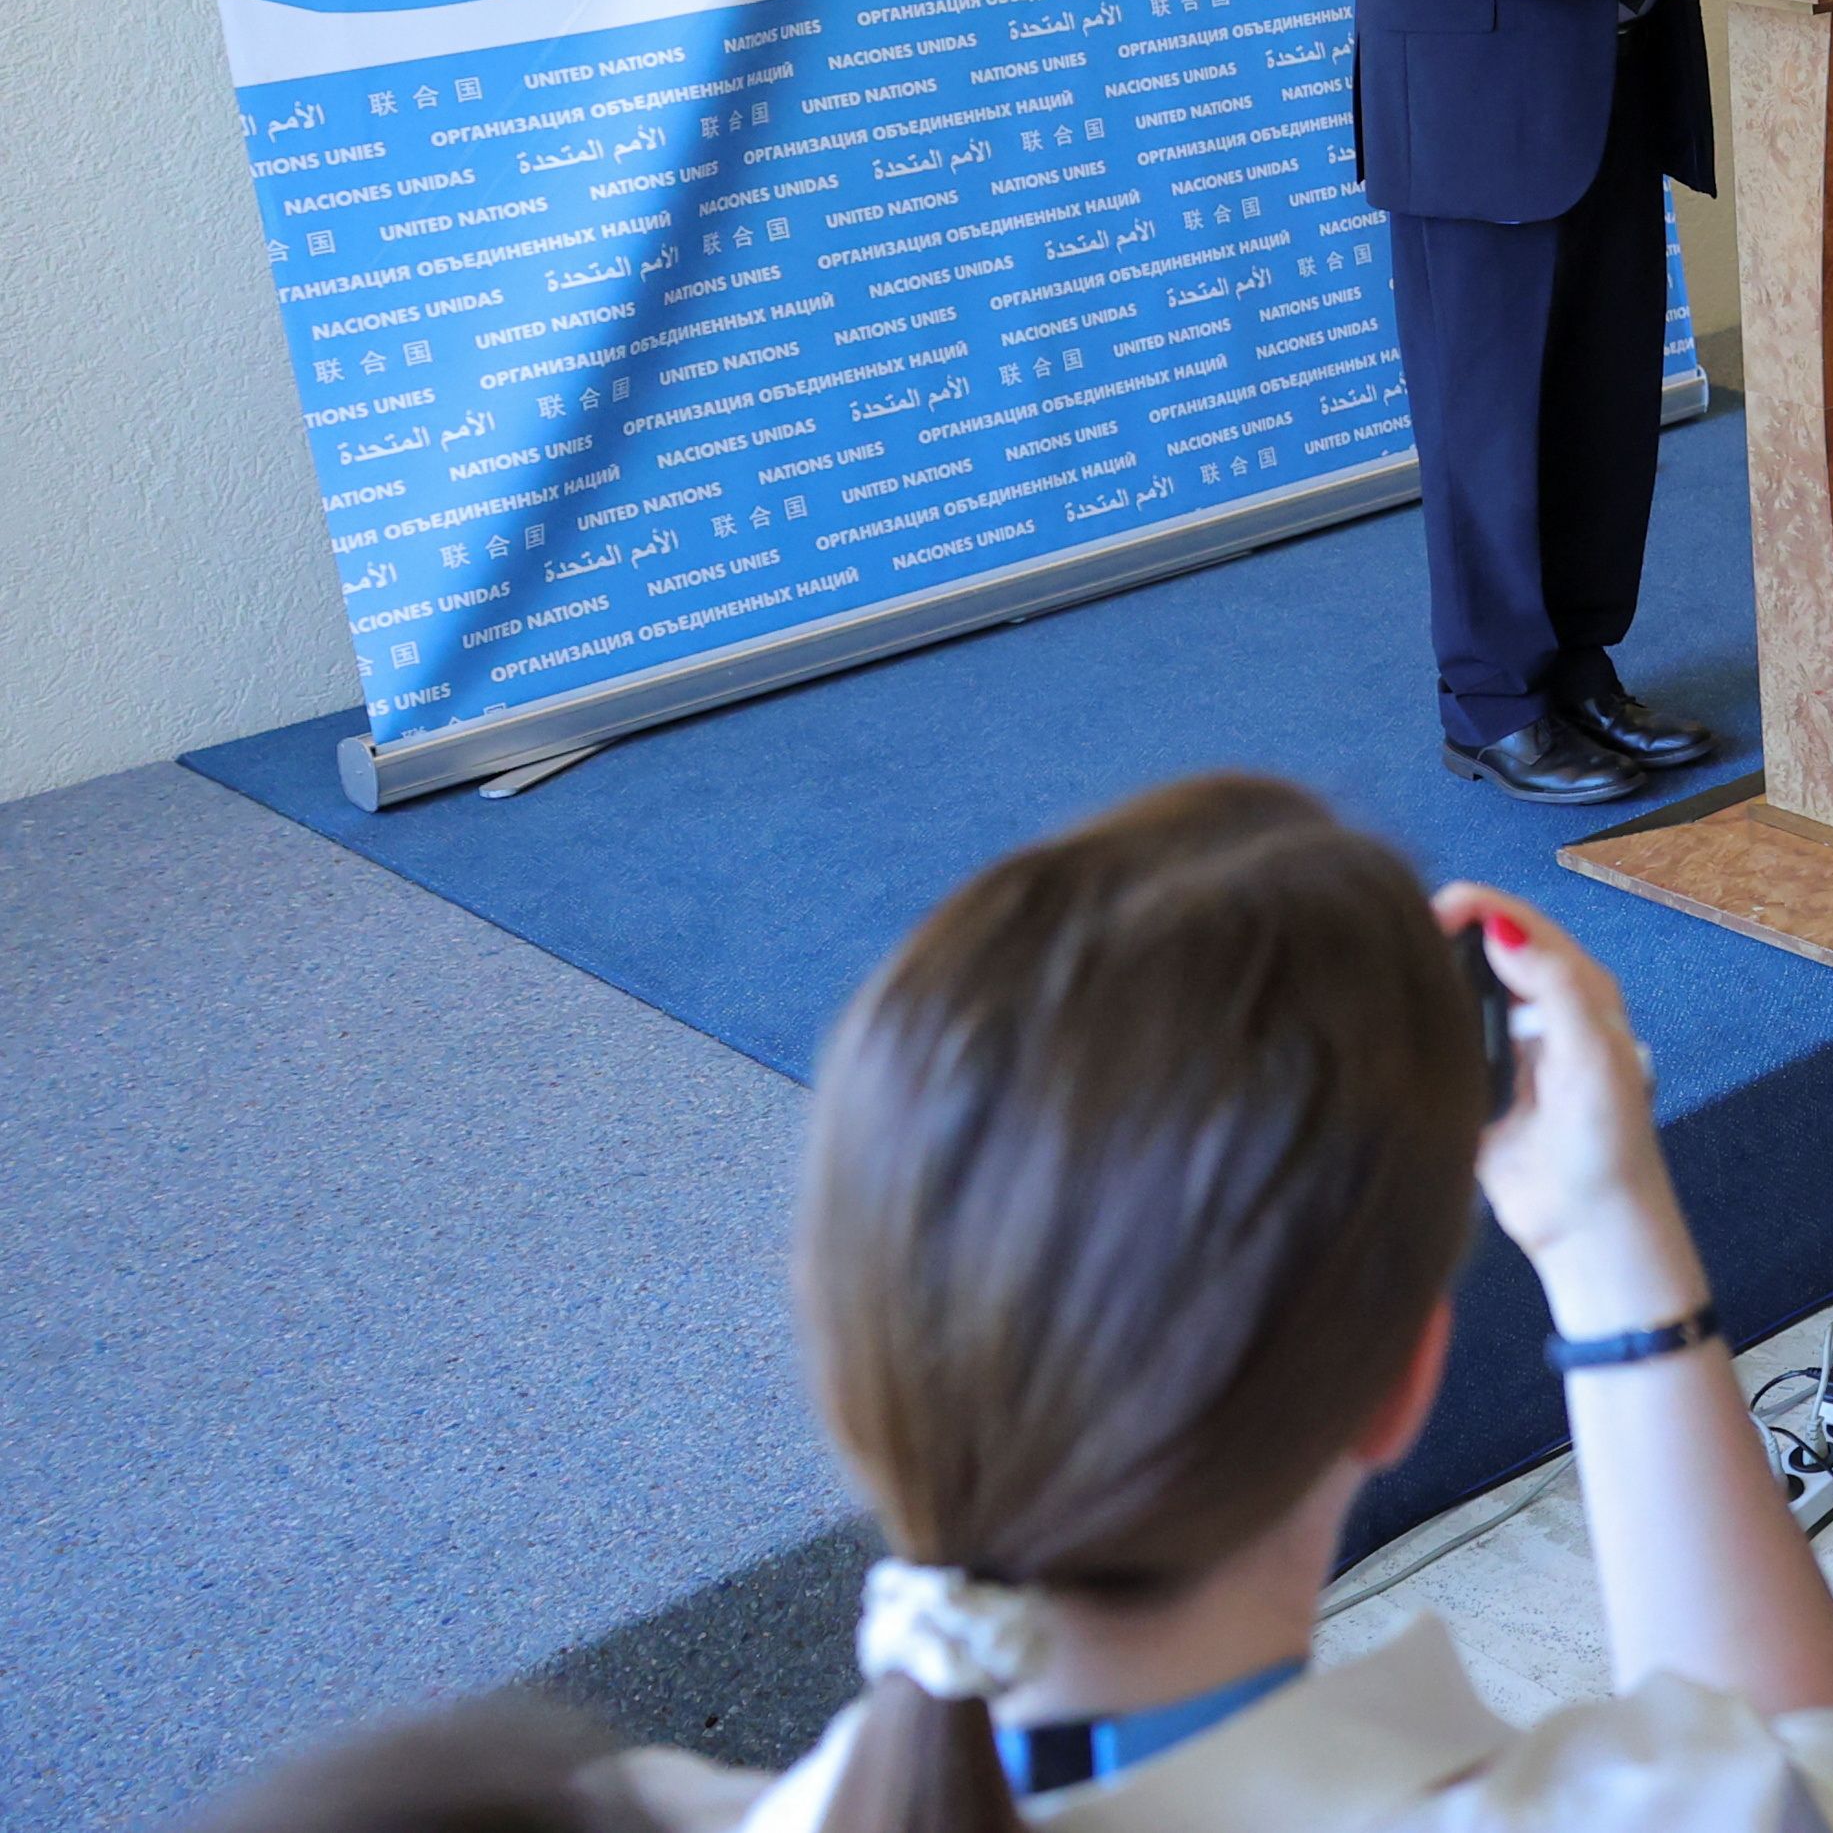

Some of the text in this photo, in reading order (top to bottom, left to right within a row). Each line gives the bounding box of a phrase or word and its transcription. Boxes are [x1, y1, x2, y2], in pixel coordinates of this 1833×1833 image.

[826, 31, 979, 72] NACIONES UNIDAS
[1117, 4, 1355, 60] ОРГАНИЗАЦИЯ ОБЪЕДИНЕННЫХ
[522, 45, 687, 91] UNITED NATIONS
[969, 50, 1089, 86] NATIONS UNIES
[1103, 60, 1239, 100] NACIONES UNIDAS
[1280, 76, 1344, 103] NATIONS
[366, 75, 484, 118] 联合国
[429, 75, 745, 148] ОРГАНИЗАЦИЯ ОБЪЕДИНЕННЫХ
[800, 76, 939, 116] UNITED NATIONS
[1134, 94, 1254, 131] UNITED NATIONS
[698, 100, 771, 140] 联合国
[742, 88, 1075, 166] ОРГАНИЗАЦИЯ ОБЪЕДИНЕННЫХ НАЦИЙ
[1019, 116, 1106, 153] 联合国
[323, 140, 388, 167] UNIES
[1136, 131, 1248, 167] ОРГАНИЗАЦИЯ
[282, 167, 477, 217] NACIONES UNIDAS
[588, 169, 677, 202] NATIONS
[772, 172, 841, 200] UNIDAS
[989, 158, 1108, 197] NATIONS UNIES
[1170, 156, 1301, 197] NACIONES UNIDAS
[1288, 184, 1339, 208] UNITED
[378, 195, 550, 243] UNITED NATIONS
[816, 187, 1142, 271] ОРГАНИЗАЦИЯ ОБЪЕДИНЕННЫХ НАЦИЙ
[824, 188, 960, 230] UNITED NATIONS
[1181, 195, 1262, 232] 联合国
[1318, 208, 1389, 238] NACIONES
[415, 209, 673, 278] ОБЪЕДИНЕННЫХ НАЦИЙ
[702, 215, 792, 257] 联合国
[729, 263, 783, 289] UNIES
[867, 253, 1016, 300] NACIONES UNIDAS
[988, 228, 1292, 312] ОРГАНИЗАЦИЯ ОБЪЕДИНЕННЫХ НАЦИЙ
[1295, 242, 1374, 279] 联合国
[310, 287, 505, 342] NACIONES UNIDAS
[473, 300, 637, 351] UNITED NATIONS
[833, 305, 959, 347] NATIONS UNIES
[999, 301, 1139, 348] NACIONES UNIDAS
[1258, 285, 1363, 324] NATIONS UNIES
[478, 290, 836, 391] ОРГАНИЗАЦИЯ НАЦИЙ
[1112, 316, 1233, 359] UNITED NATIONS
[1254, 316, 1380, 361] NACIONES UNIDAS
[311, 338, 434, 386] 联合国
[658, 340, 802, 387] UNITED NATIONS
[997, 346, 1085, 388] 联合国
[372, 386, 437, 415] UNIES
[535, 375, 631, 420] 联合国
[622, 339, 970, 437] ОРГАНИЗАЦИЯ ОБЪЕДИНЕННЫХ НАЦИЙ
[917, 352, 1229, 445] ОРГАНИЗАЦИЯ ОБЪЕДИНЕННЫХ НАЦИЙ
[1147, 383, 1259, 425] ОРГАНИЗАЦИЯ
[1258, 352, 1379, 396] ОБЪЕДИНЕННЫХ
[655, 416, 818, 470] NACIONES UNIDAS
[1004, 419, 1120, 463] NATIONS UNIES
[1165, 409, 1295, 458] NACIONES UNIDAS
[1303, 413, 1413, 456] UNITED NATIONS
[447, 446, 542, 483] NATIONS
[757, 439, 886, 486] NATIONS UNIES
[840, 456, 974, 505] UNITED NATIONS
[1198, 444, 1279, 486] 联合国
[382, 484, 560, 541] ОБЪЕДИНЕННЫХ
[576, 480, 724, 532] UNITED NATIONS
[709, 493, 809, 540] 联合国
[814, 450, 1138, 552] ОРГАНИЗАЦИЯ ОБЪЕДИНЕННЫХ НАЦИЙ
[438, 522, 546, 571] 联合国
[891, 517, 1037, 572] NACIONES UNIDAS
[645, 547, 782, 598] NATIONS UNIES
[436, 580, 512, 613] UNIDAS
[525, 593, 611, 631] NATIONS
[489, 564, 861, 684] ОРГАНИЗАЦИЯ ОБЪЕДИНЕННЫХ НАЦИЙ
[393, 681, 452, 712] UNIES
